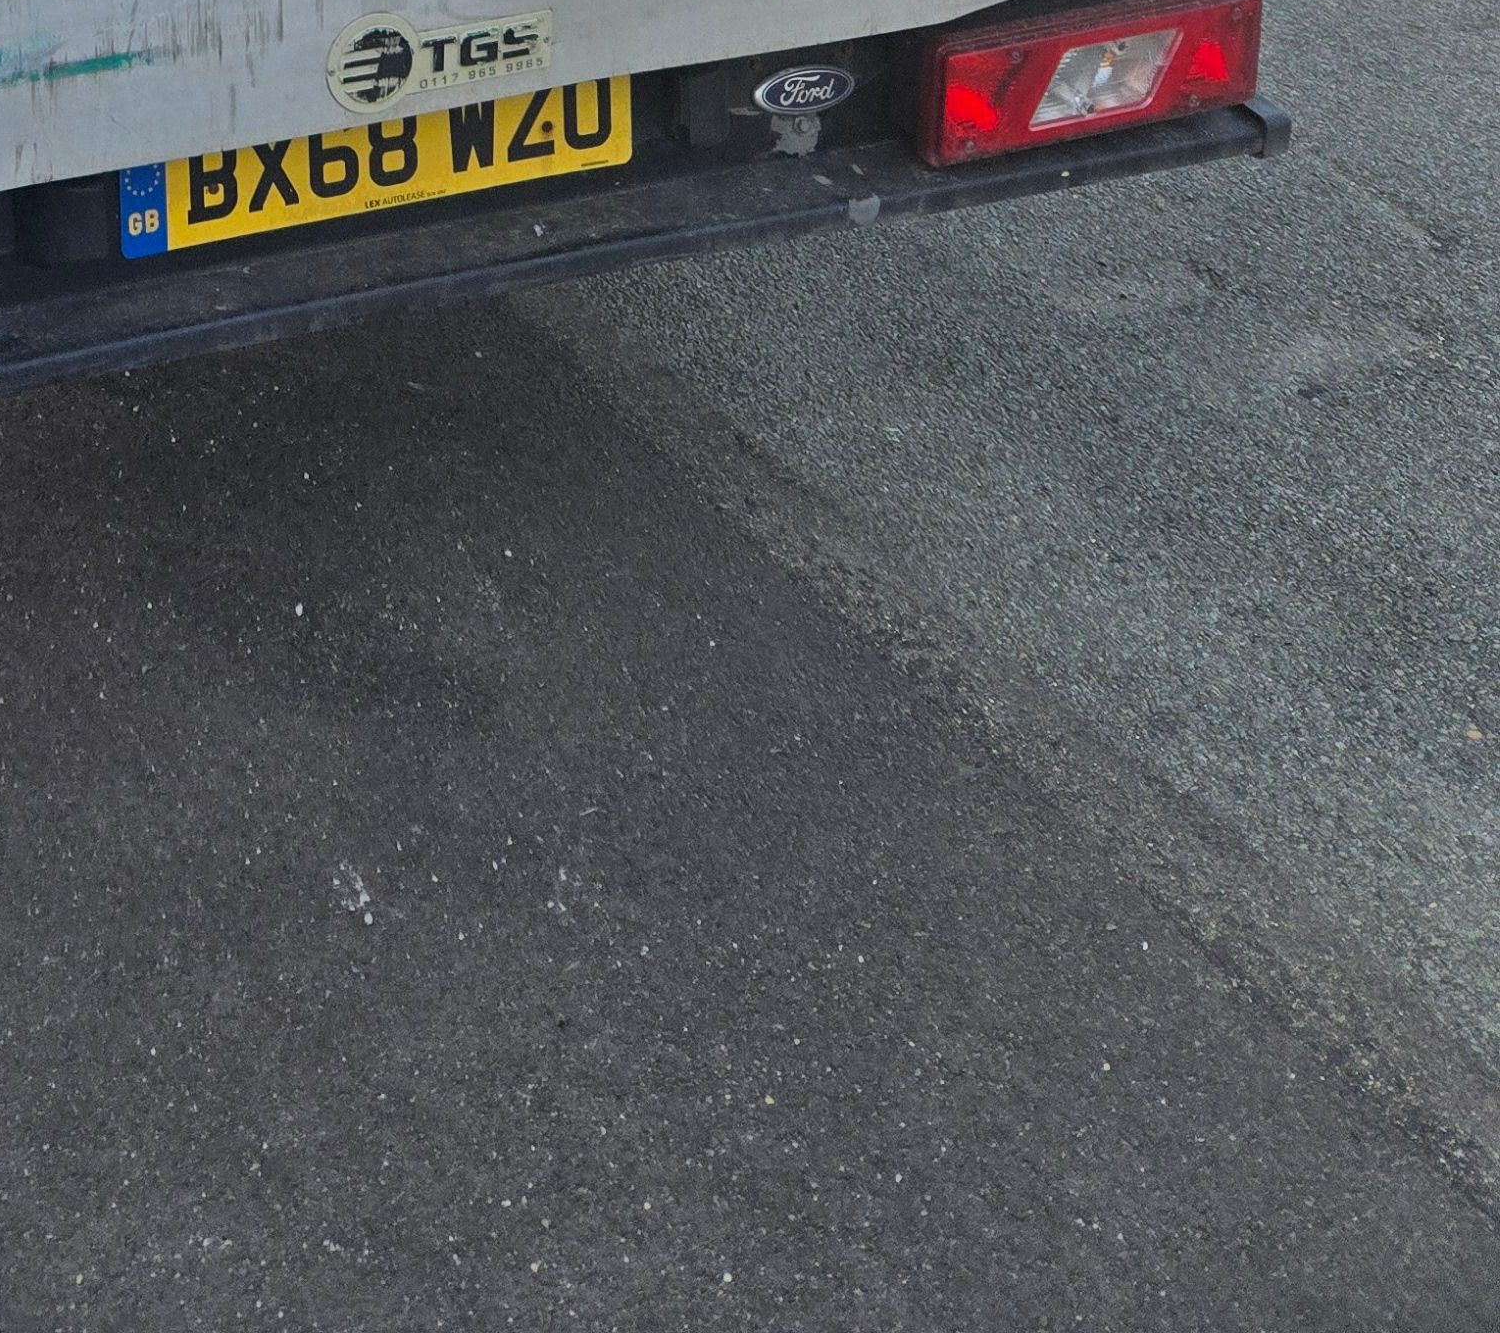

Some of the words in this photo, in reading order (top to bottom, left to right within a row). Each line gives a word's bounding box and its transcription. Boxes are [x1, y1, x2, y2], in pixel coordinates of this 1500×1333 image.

[421, 24, 539, 73] TGS
[420, 73, 459, 89] 0117
[468, 66, 496, 80] 965
[779, 74, 835, 106] Ford
[364, 199, 381, 210] LEX
[382, 190, 425, 205] AUTOLEASE
[128, 209, 159, 236] GB
